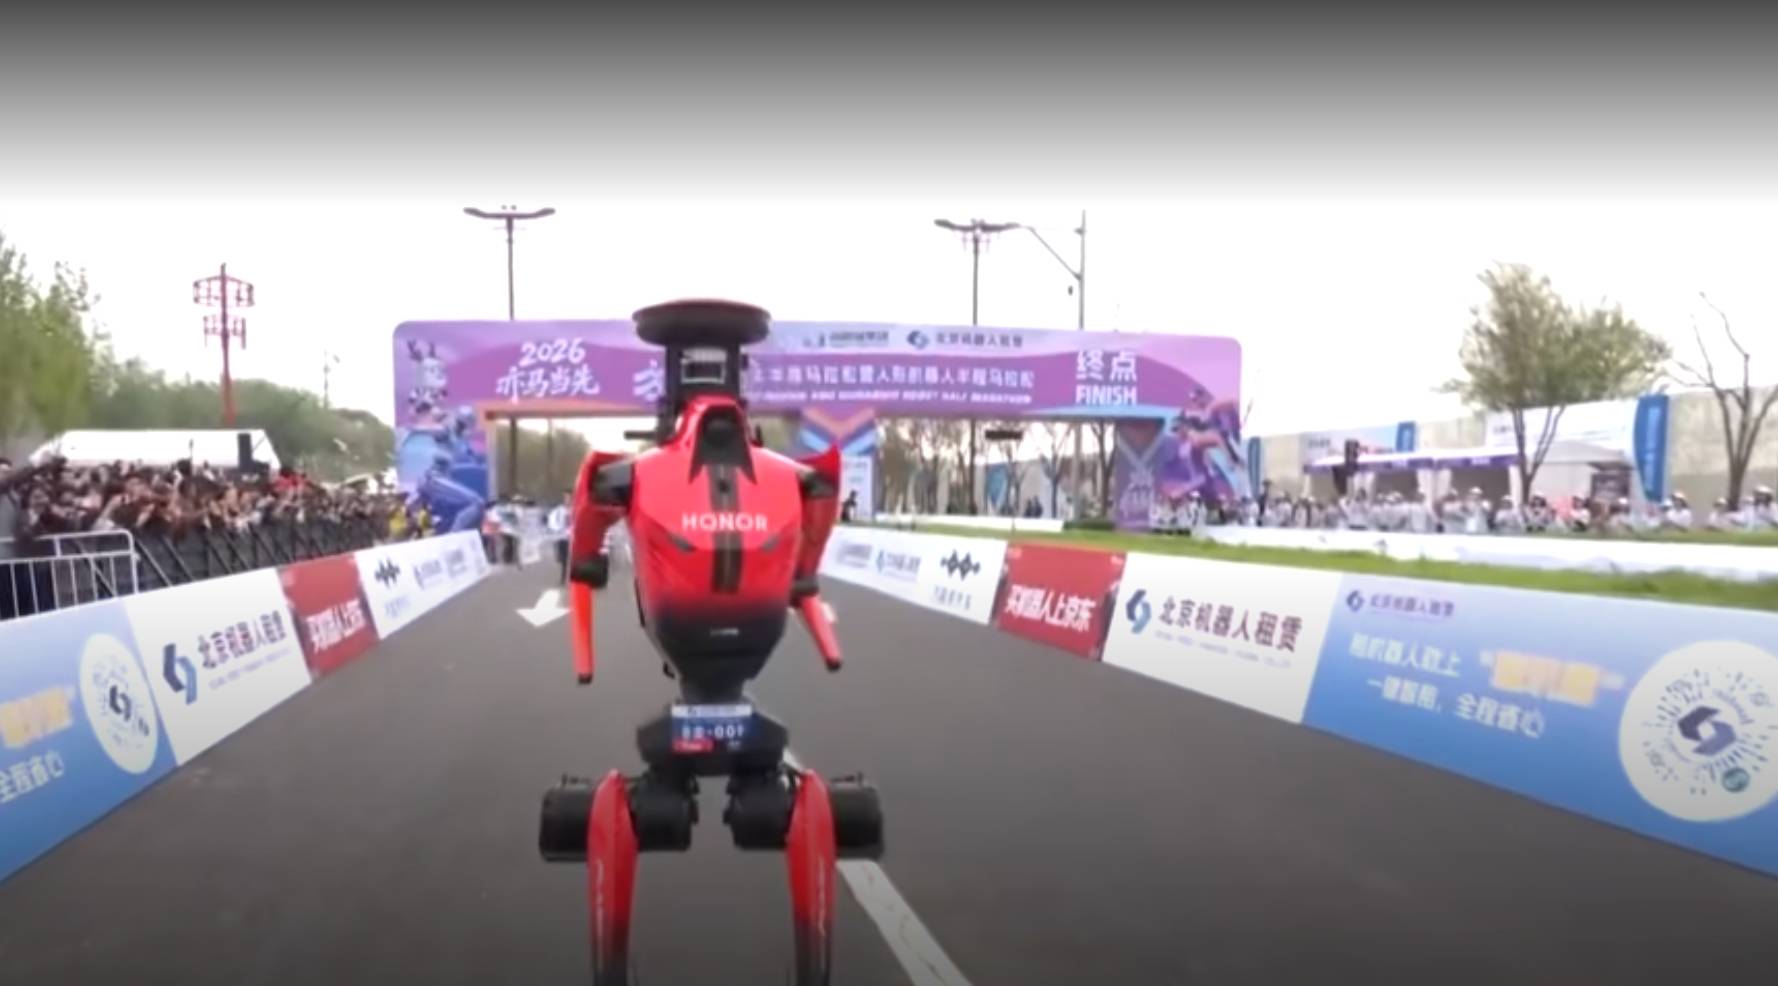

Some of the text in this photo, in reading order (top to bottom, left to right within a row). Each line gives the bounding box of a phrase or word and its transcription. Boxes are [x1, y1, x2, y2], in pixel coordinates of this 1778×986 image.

[518, 337, 587, 367] 2026
[1076, 350, 1137, 381] 终点
[1075, 384, 1137, 405] FINISH
[681, 512, 768, 532] HONOR
[1158, 596, 1303, 653] 北京机器人租赁
